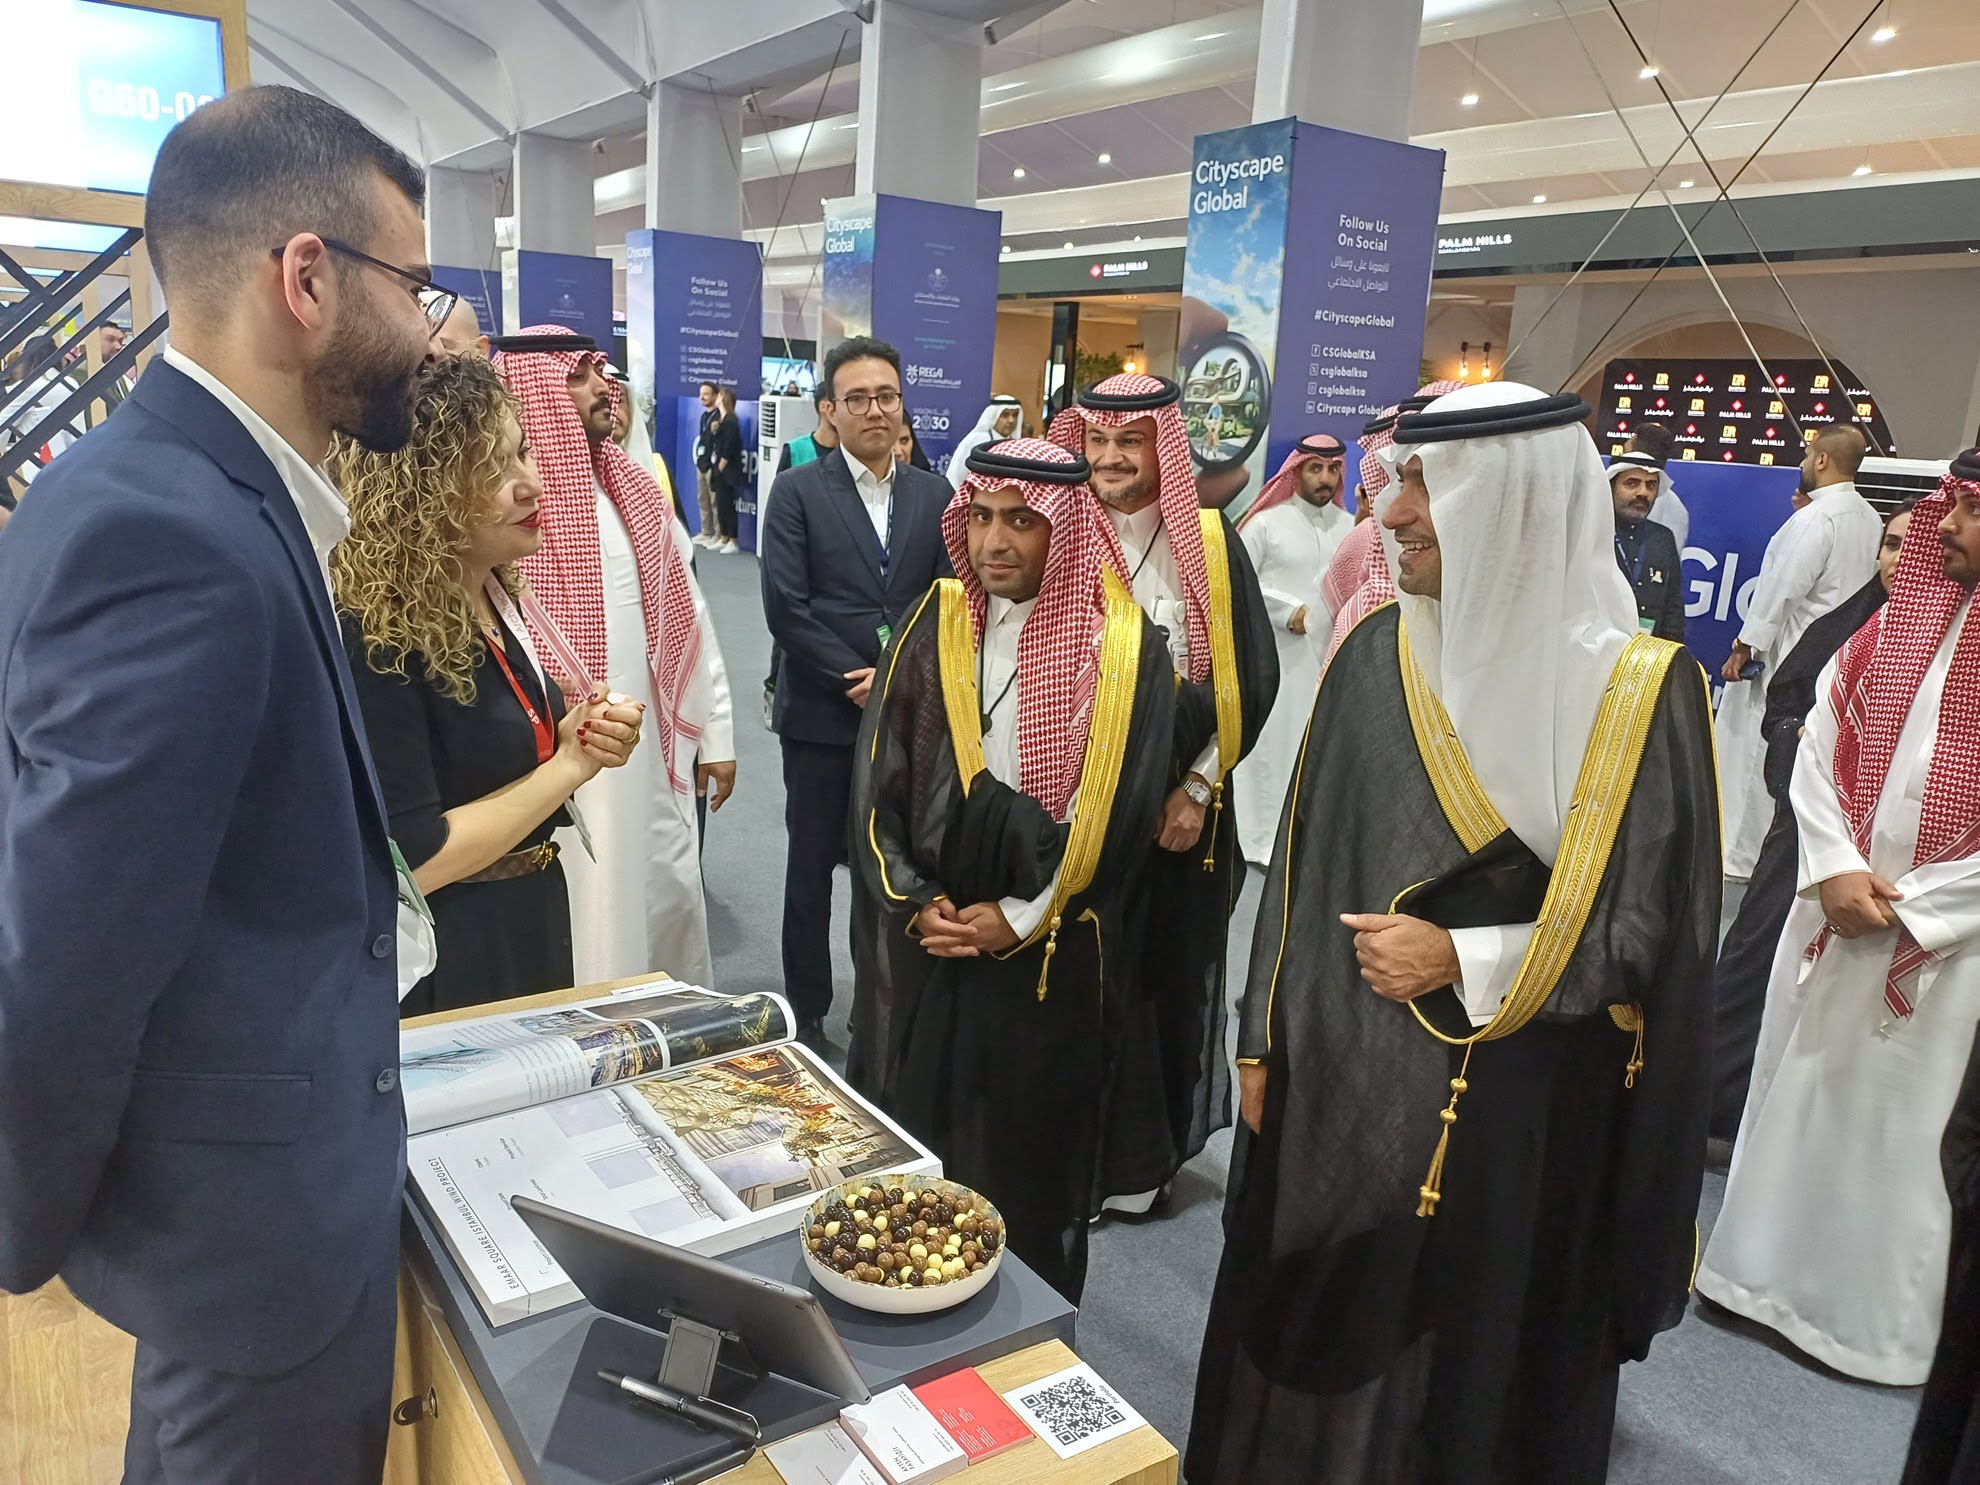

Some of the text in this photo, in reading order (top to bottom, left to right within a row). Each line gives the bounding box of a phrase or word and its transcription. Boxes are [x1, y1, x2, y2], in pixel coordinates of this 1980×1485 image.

[1195, 154, 1284, 188] Cityscape
[1193, 185, 1248, 214] Global
[826, 216, 873, 236] Cityscape
[1339, 214, 1390, 234] Follow Us
[825, 235, 856, 254] Global
[1337, 232, 1388, 251] On Social
[1438, 233, 1512, 249] PALM HILLS
[1314, 309, 1395, 328] #CityscapeGlobal
[1322, 346, 1376, 361] CSGlobalKSA
[1320, 365, 1368, 379] csglobalksa
[1318, 385, 1366, 398] csglobalksa
[1316, 402, 1356, 416] Cityscape
[427, 1157, 520, 1290] EMAAR SQUARE ISTANBUL WIND PROJECT
[892, 1455, 909, 1473] AYTEN
